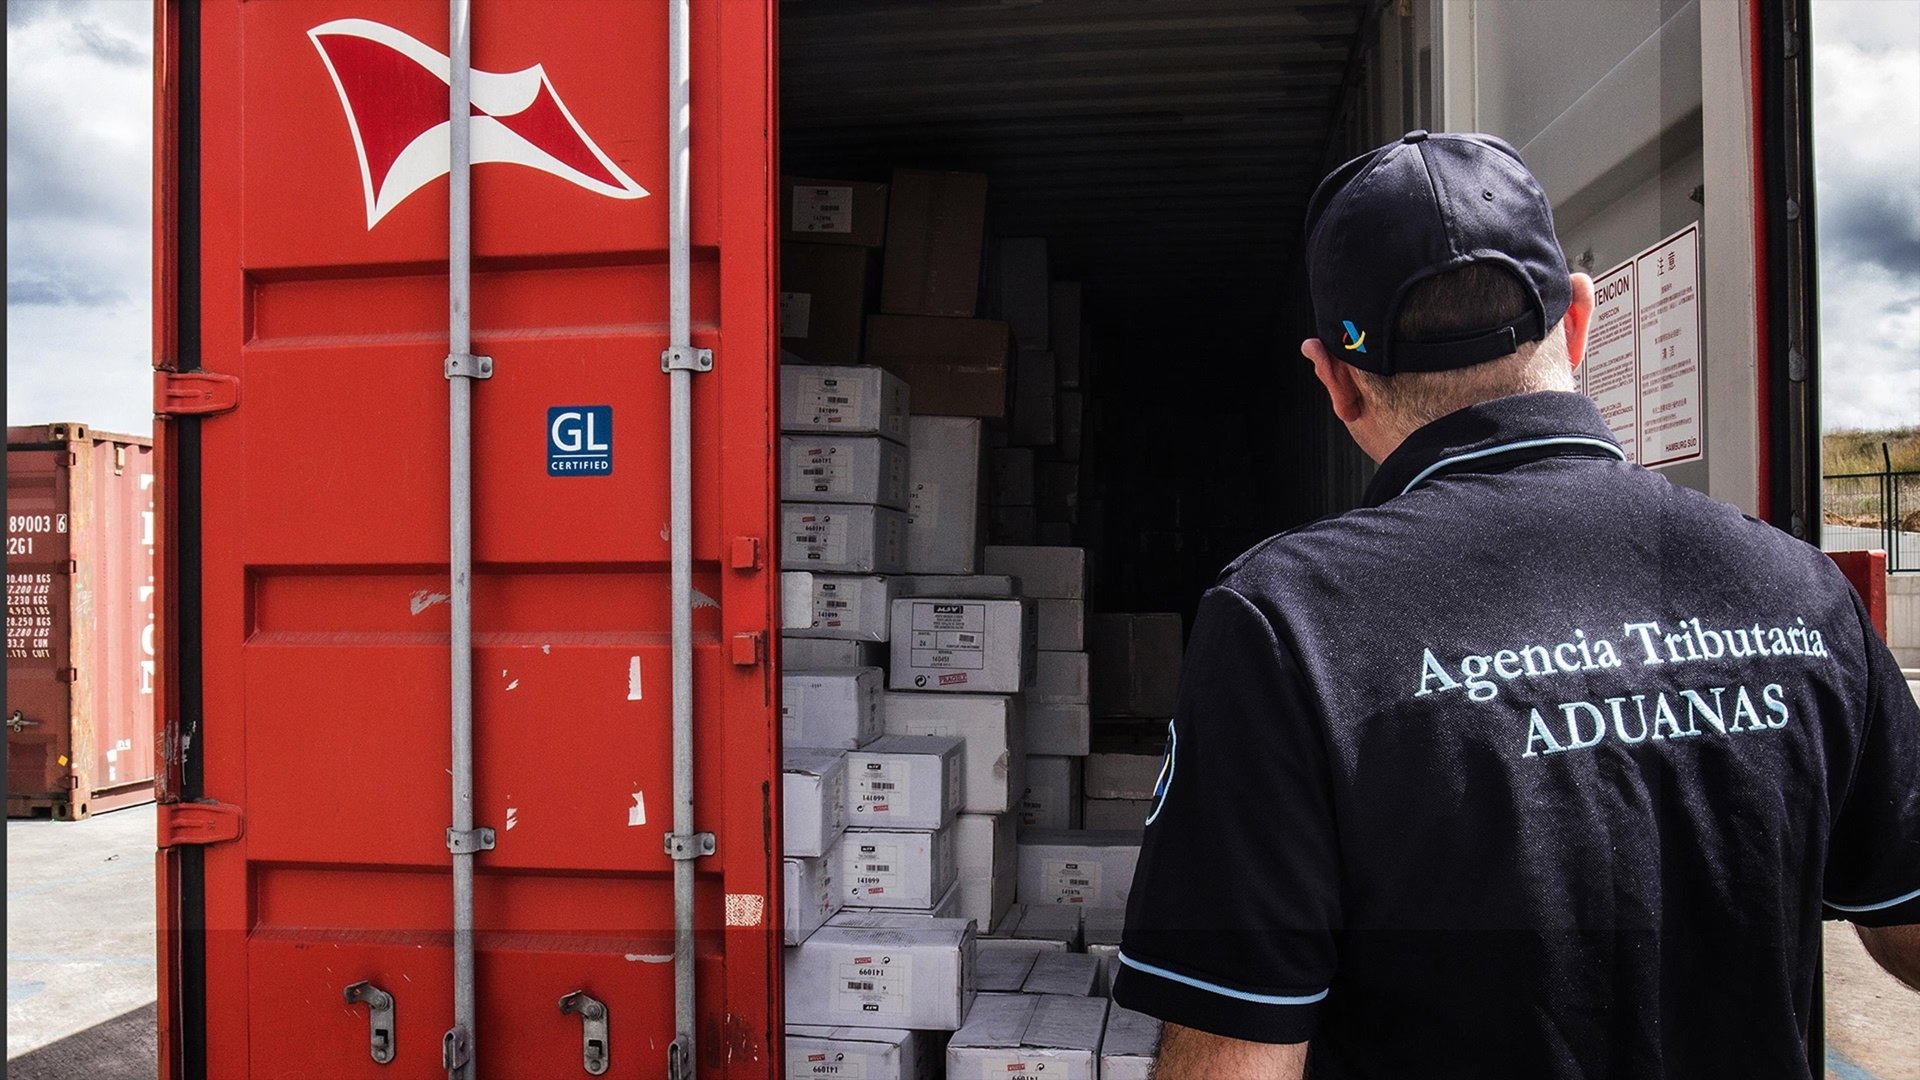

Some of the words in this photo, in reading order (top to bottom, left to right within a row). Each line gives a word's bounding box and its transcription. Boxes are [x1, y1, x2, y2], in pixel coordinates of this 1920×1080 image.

[1594, 275, 1629, 307] TENCION
[551, 412, 608, 451] GL
[551, 461, 608, 470] CERTIFIED
[9, 515, 51, 533] 89003
[36, 574, 51, 583] KGS
[6, 585, 32, 594] 7.200
[34, 585, 50, 594] LBS
[33, 595, 48, 605] KGS
[34, 606, 50, 615] LBS
[36, 617, 51, 626] KGS
[6, 628, 32, 637] 2.280
[34, 628, 50, 637] LBS
[1414, 629, 1621, 703] Agencia
[1624, 616, 1828, 667] Tributaria
[1522, 683, 1790, 759] ADUANAS
[856, 876, 880, 885] 141099
[859, 968, 885, 977] 141099
[812, 1065, 839, 1074] 141099
